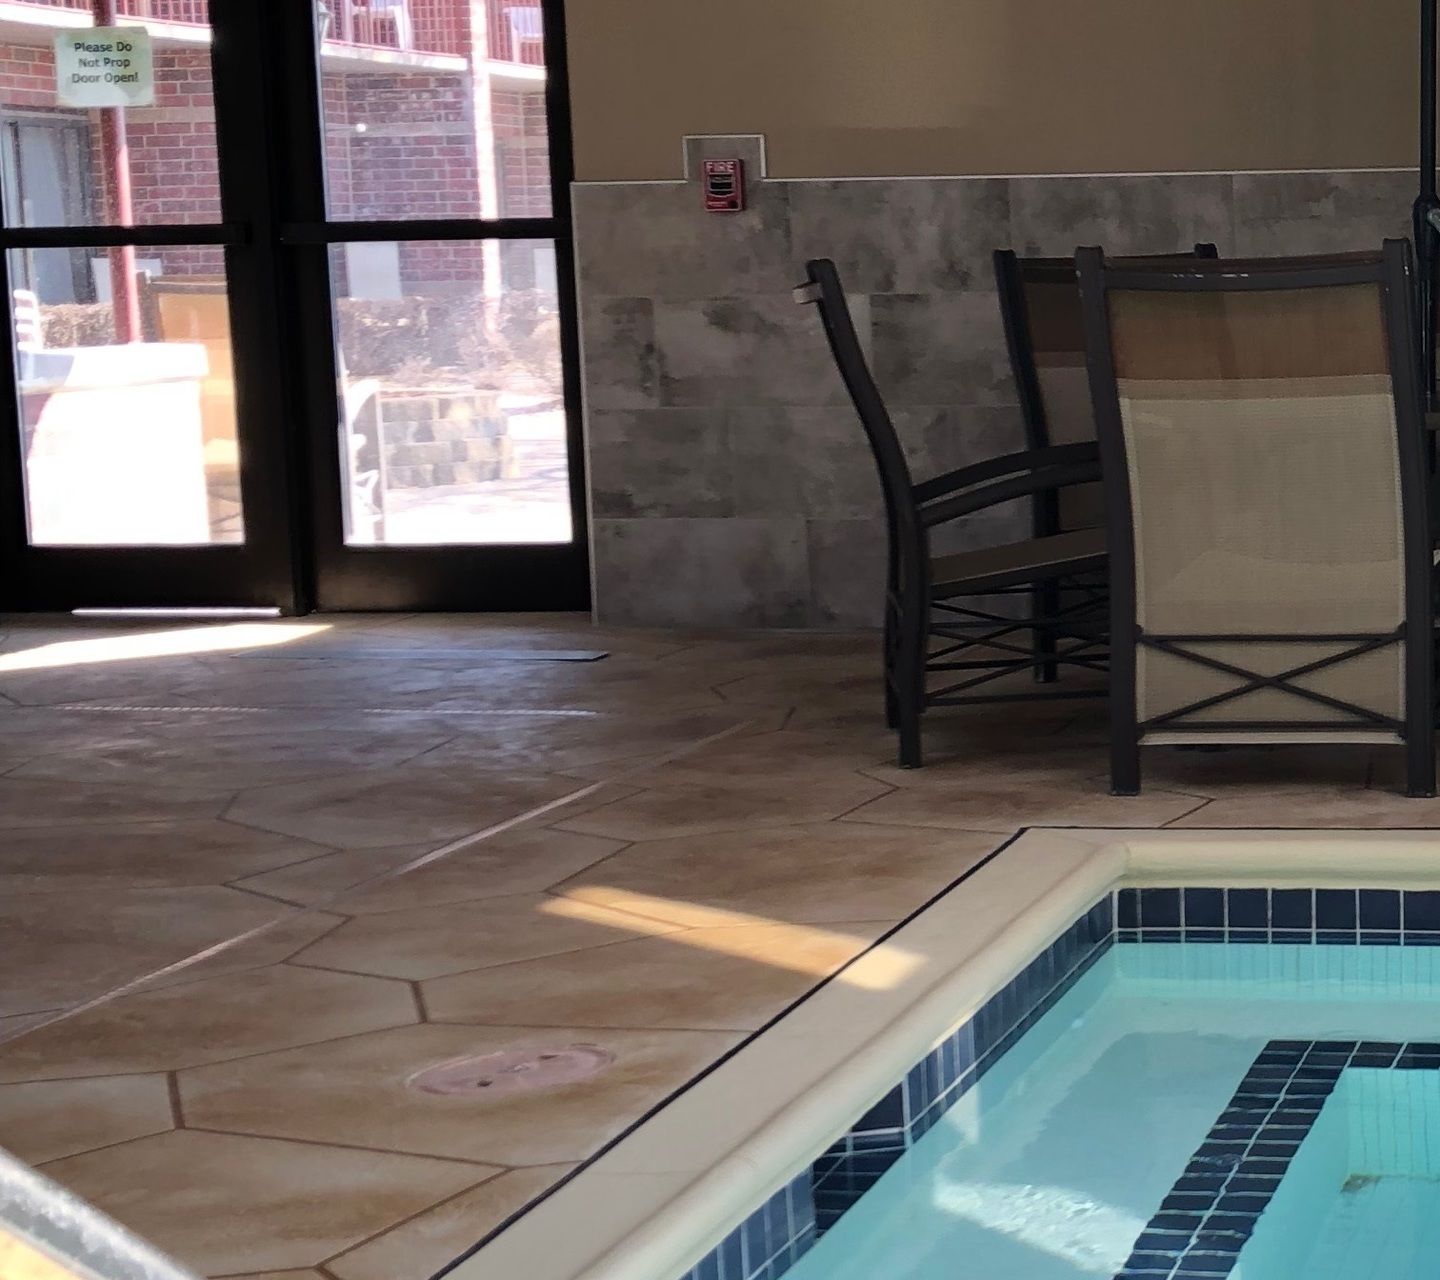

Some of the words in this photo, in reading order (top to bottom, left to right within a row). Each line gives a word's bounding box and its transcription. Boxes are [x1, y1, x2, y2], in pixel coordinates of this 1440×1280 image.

[74, 42, 113, 52] Please
[116, 41, 133, 52] Do
[79, 58, 100, 68] Not
[103, 57, 131, 69] Prop
[71, 73, 101, 83] Door
[104, 72, 139, 84] Open!
[706, 162, 734, 172] FIRE
